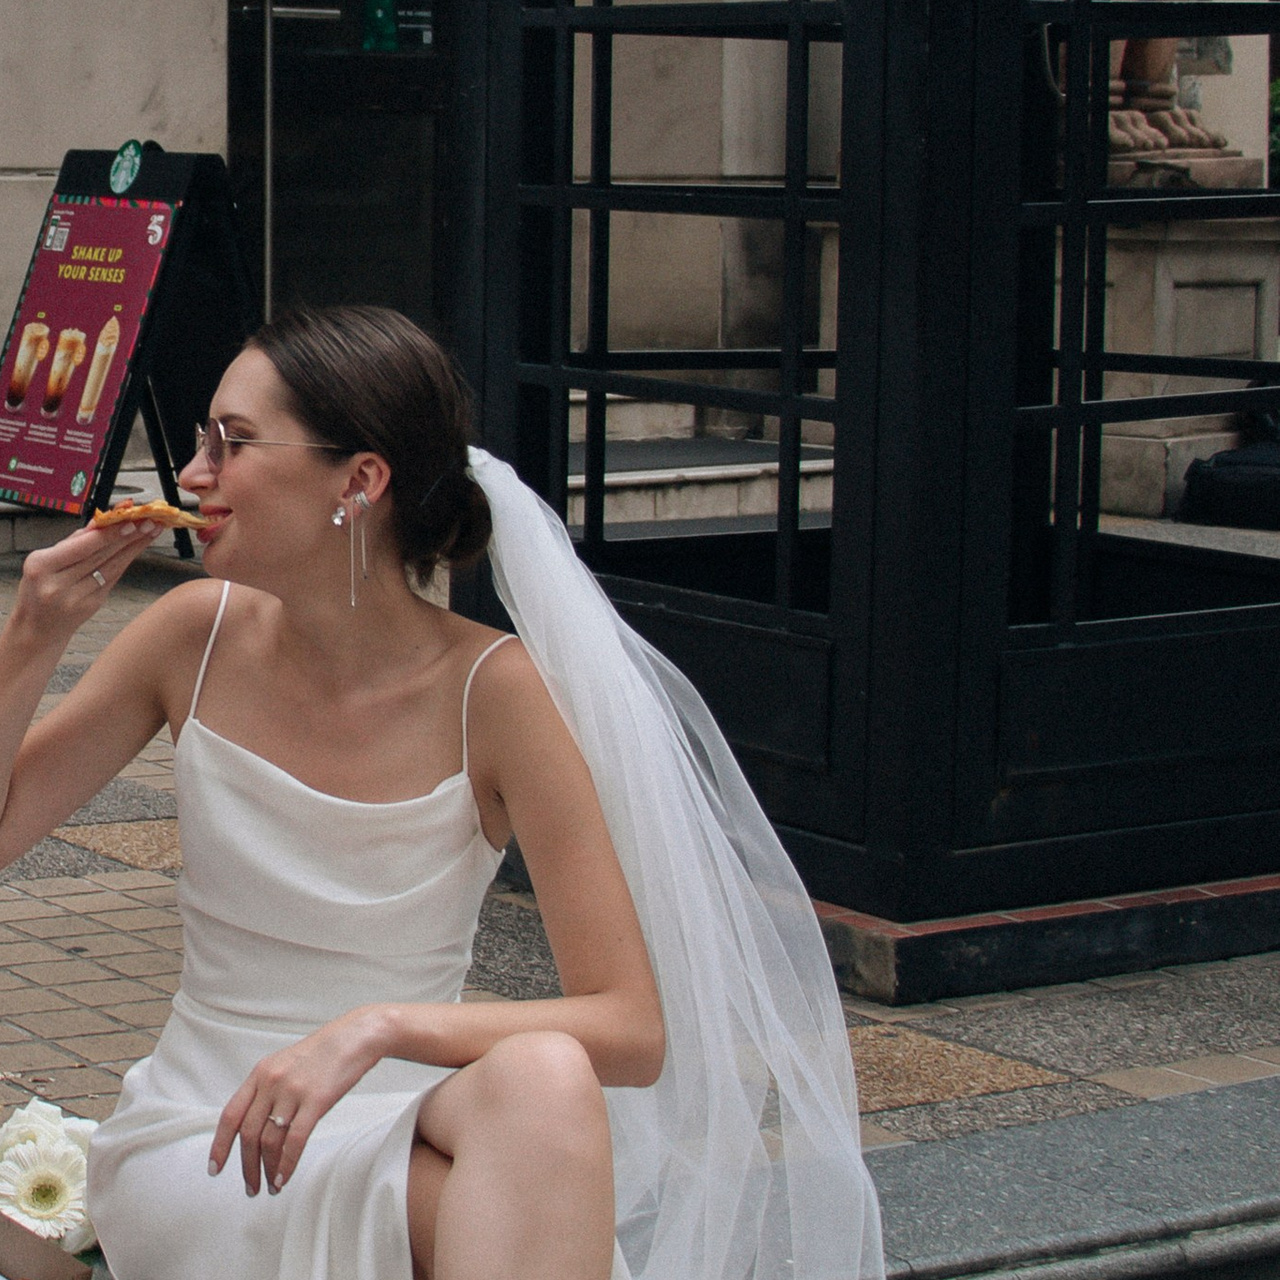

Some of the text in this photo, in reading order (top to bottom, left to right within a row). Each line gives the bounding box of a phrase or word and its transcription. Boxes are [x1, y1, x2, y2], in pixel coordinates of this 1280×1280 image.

[71, 245, 123, 263] SHAKE UP
[58, 264, 126, 284] YOUR SENSES
